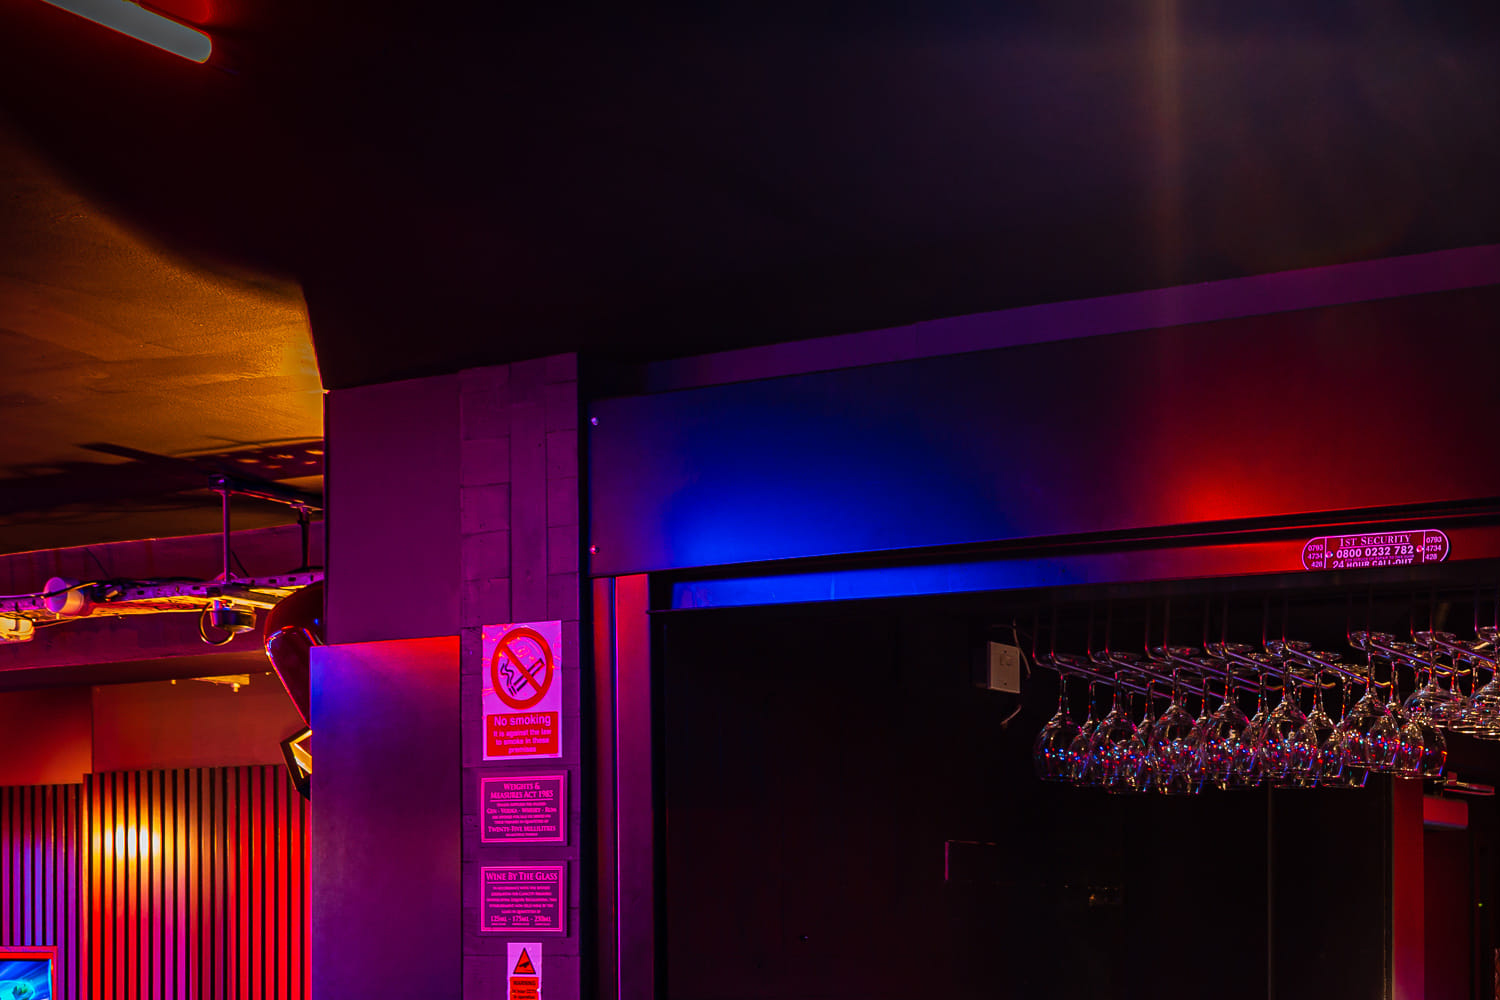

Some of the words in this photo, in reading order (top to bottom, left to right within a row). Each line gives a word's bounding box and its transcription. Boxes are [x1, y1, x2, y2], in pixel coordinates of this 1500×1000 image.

[1340, 538, 1358, 546] 1ST
[1360, 534, 1412, 545] SECURITY
[1336, 548, 1362, 558] 0800
[1365, 546, 1390, 557] 0232
[1394, 545, 1414, 555] 782
[494, 716, 507, 726] No
[510, 714, 551, 726] smoking
[506, 729, 528, 738] against
[490, 791, 522, 799] MEASURES
[538, 790, 554, 798] 1985
[486, 872, 506, 880] WINE
[508, 872, 518, 880] BY
[518, 872, 534, 880] THE
[535, 872, 558, 880] GLASS
